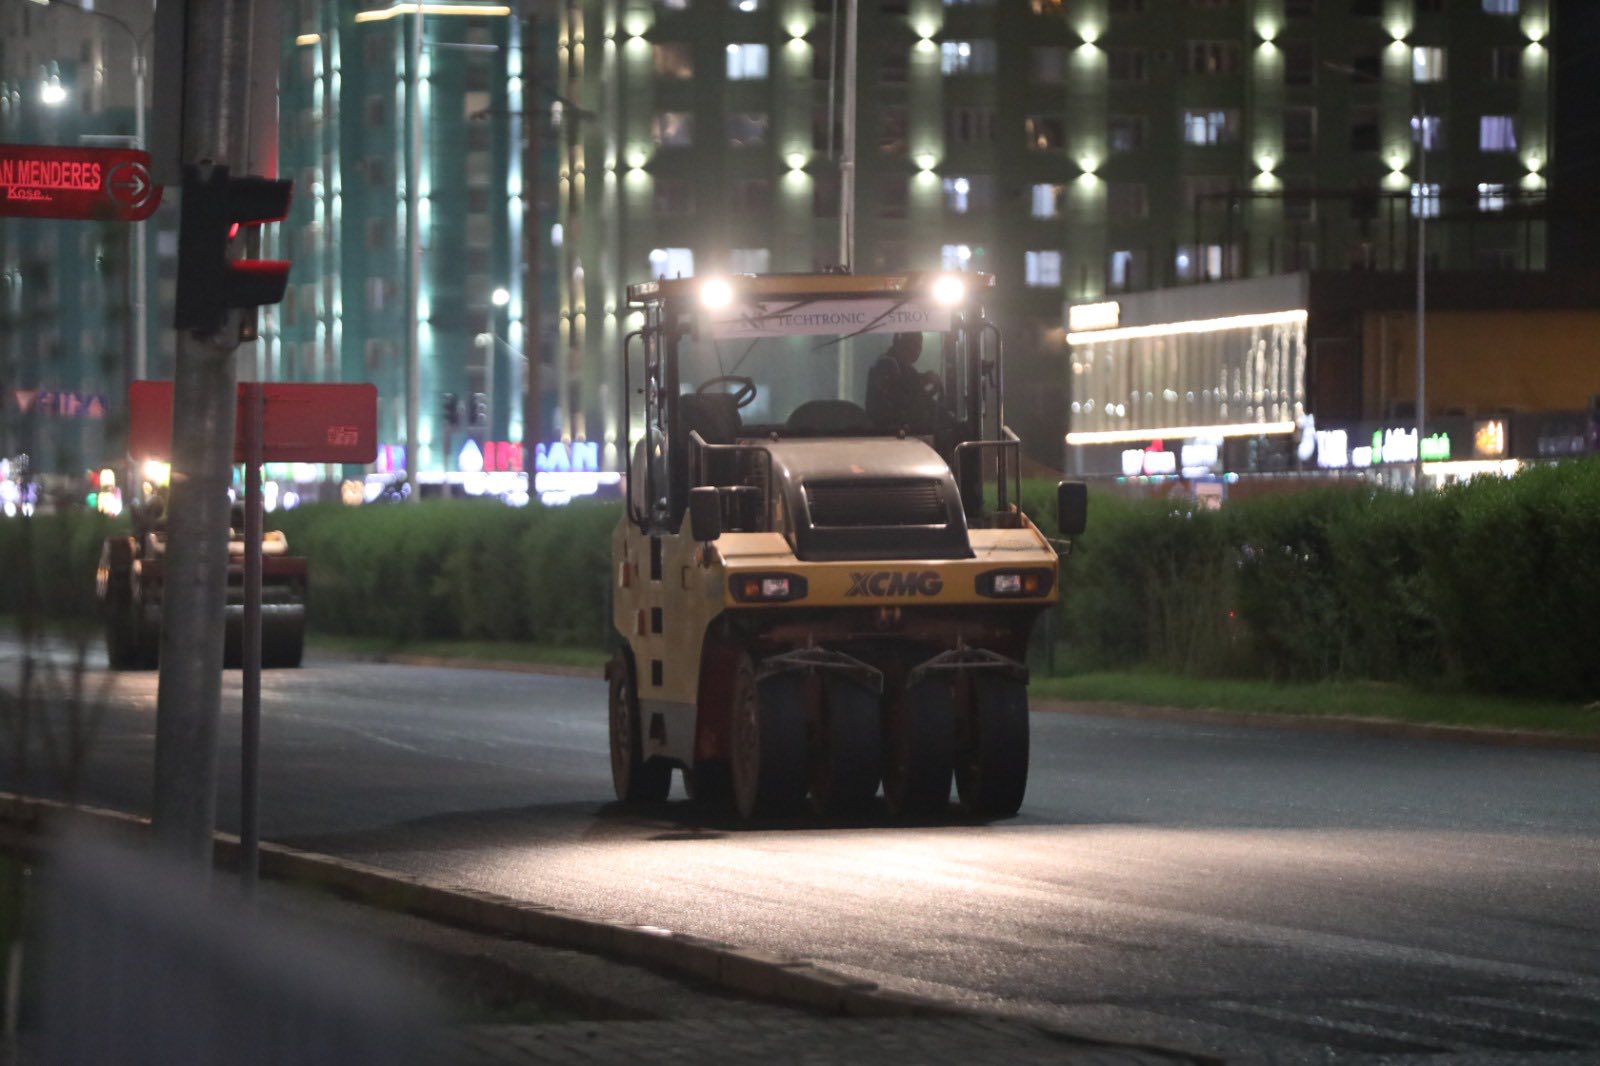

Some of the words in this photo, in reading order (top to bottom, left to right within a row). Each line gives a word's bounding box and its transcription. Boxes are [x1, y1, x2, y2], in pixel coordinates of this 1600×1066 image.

[18, 159, 101, 189] MENDERES
[777, 311, 865, 327] TECHTRONIC
[887, 310, 931, 324] STROY
[844, 571, 944, 597] XCMG
